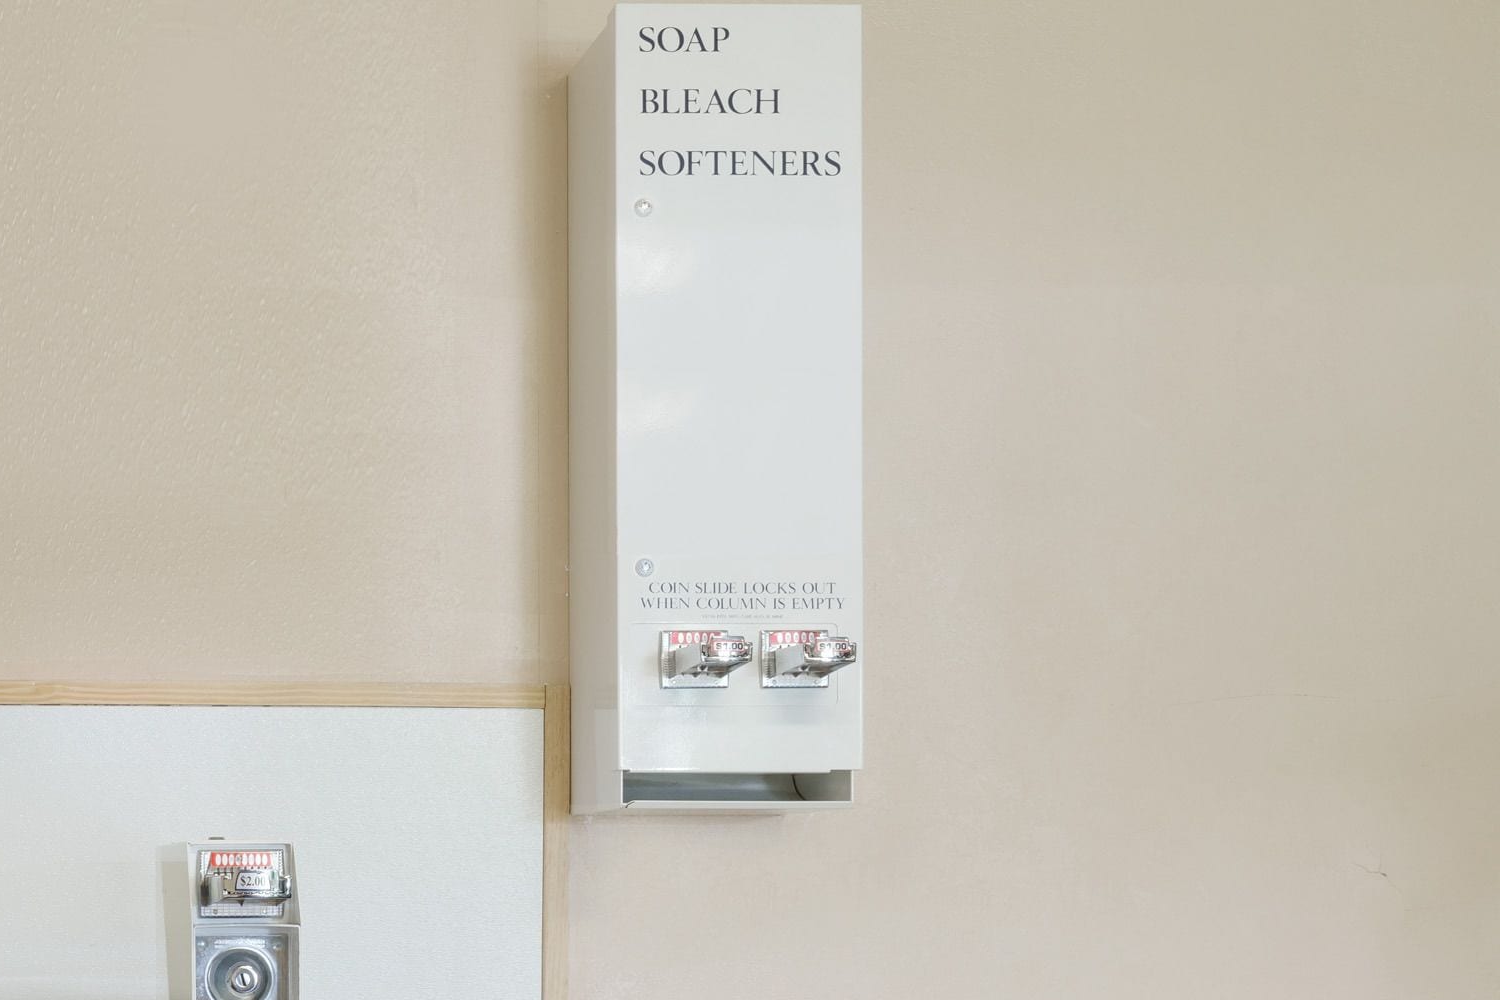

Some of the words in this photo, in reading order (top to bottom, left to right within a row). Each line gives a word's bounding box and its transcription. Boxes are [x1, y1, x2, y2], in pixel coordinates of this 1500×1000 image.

[638, 26, 731, 53] SOAP
[640, 88, 781, 115] BLEACH
[638, 150, 842, 177] SOFTENERS
[648, 582, 690, 595] COIN
[695, 582, 738, 595] SLIDE
[744, 582, 796, 595] LOCKS
[802, 582, 836, 595] OUT
[640, 597, 690, 610] WHEN
[696, 597, 767, 610] COLUMN
[773, 597, 786, 610] IS
[792, 597, 845, 610] EMPTY
[240, 876, 266, 887] $2.00
